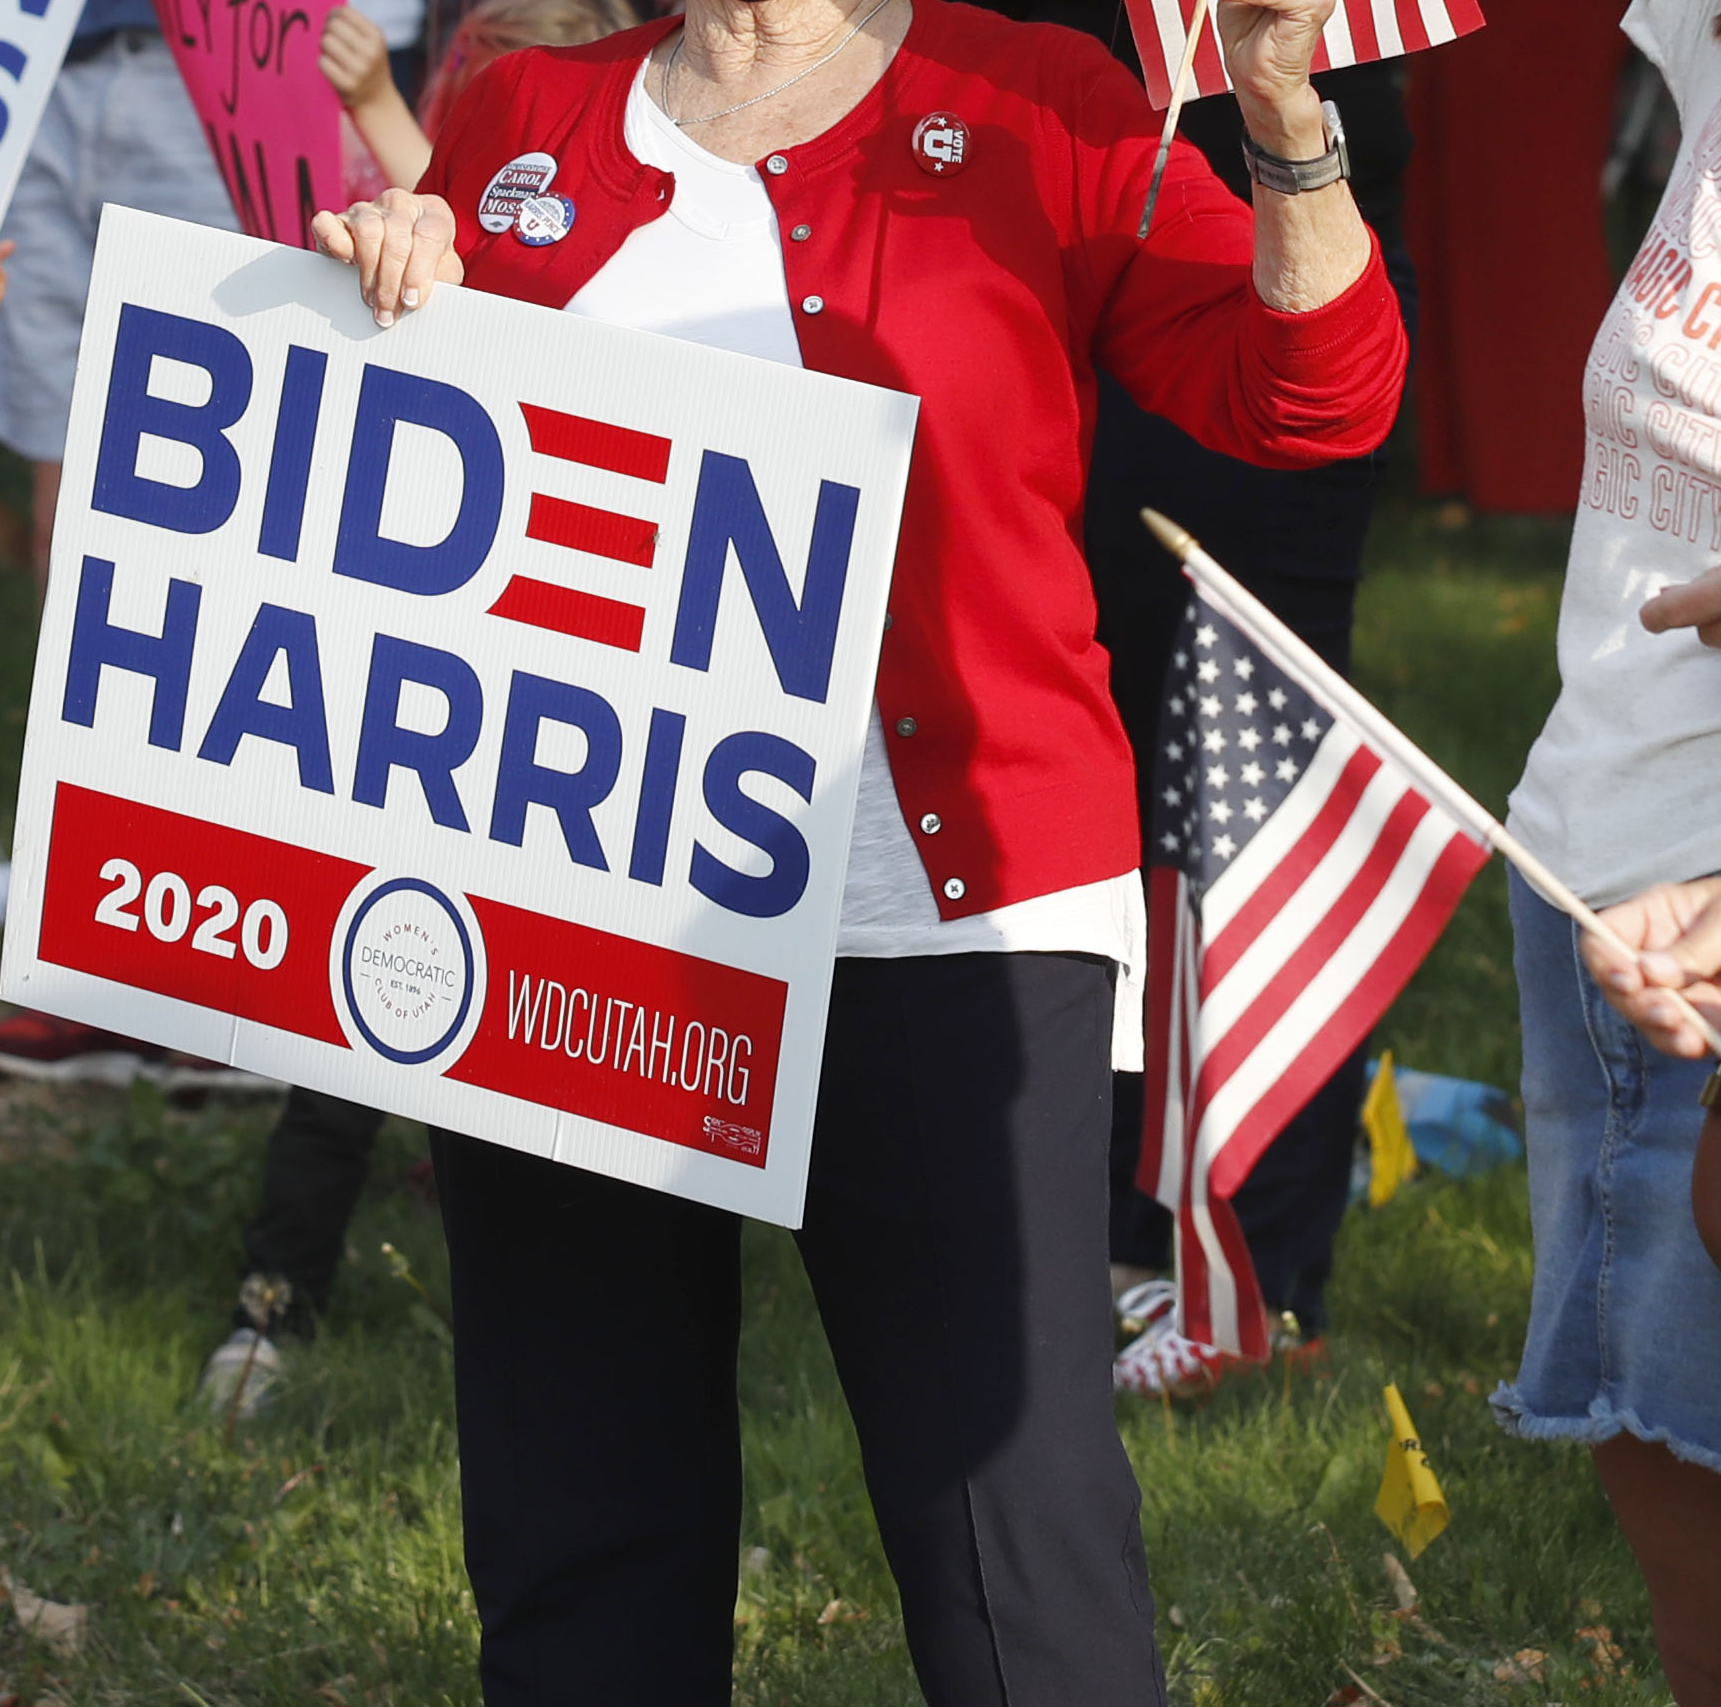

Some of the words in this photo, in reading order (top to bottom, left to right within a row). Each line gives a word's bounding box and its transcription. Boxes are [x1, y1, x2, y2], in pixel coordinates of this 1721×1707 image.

[951, 130, 965, 164] VOTE
[498, 170, 543, 186] CAROL
[90, 301, 863, 705] BIDEN
[60, 553, 818, 920] HARRIS
[382, 923, 440, 957] WOMEN'S
[93, 857, 292, 972] 2020
[506, 969, 753, 1107] WDCUTAH.ORG
[361, 945, 456, 988] DEMOCRATIC
[374, 977, 393, 1011] CLUB
[395, 1007, 409, 1020] OF
[412, 992, 437, 1019] UTAH
[405, 982, 422, 995] 1896
